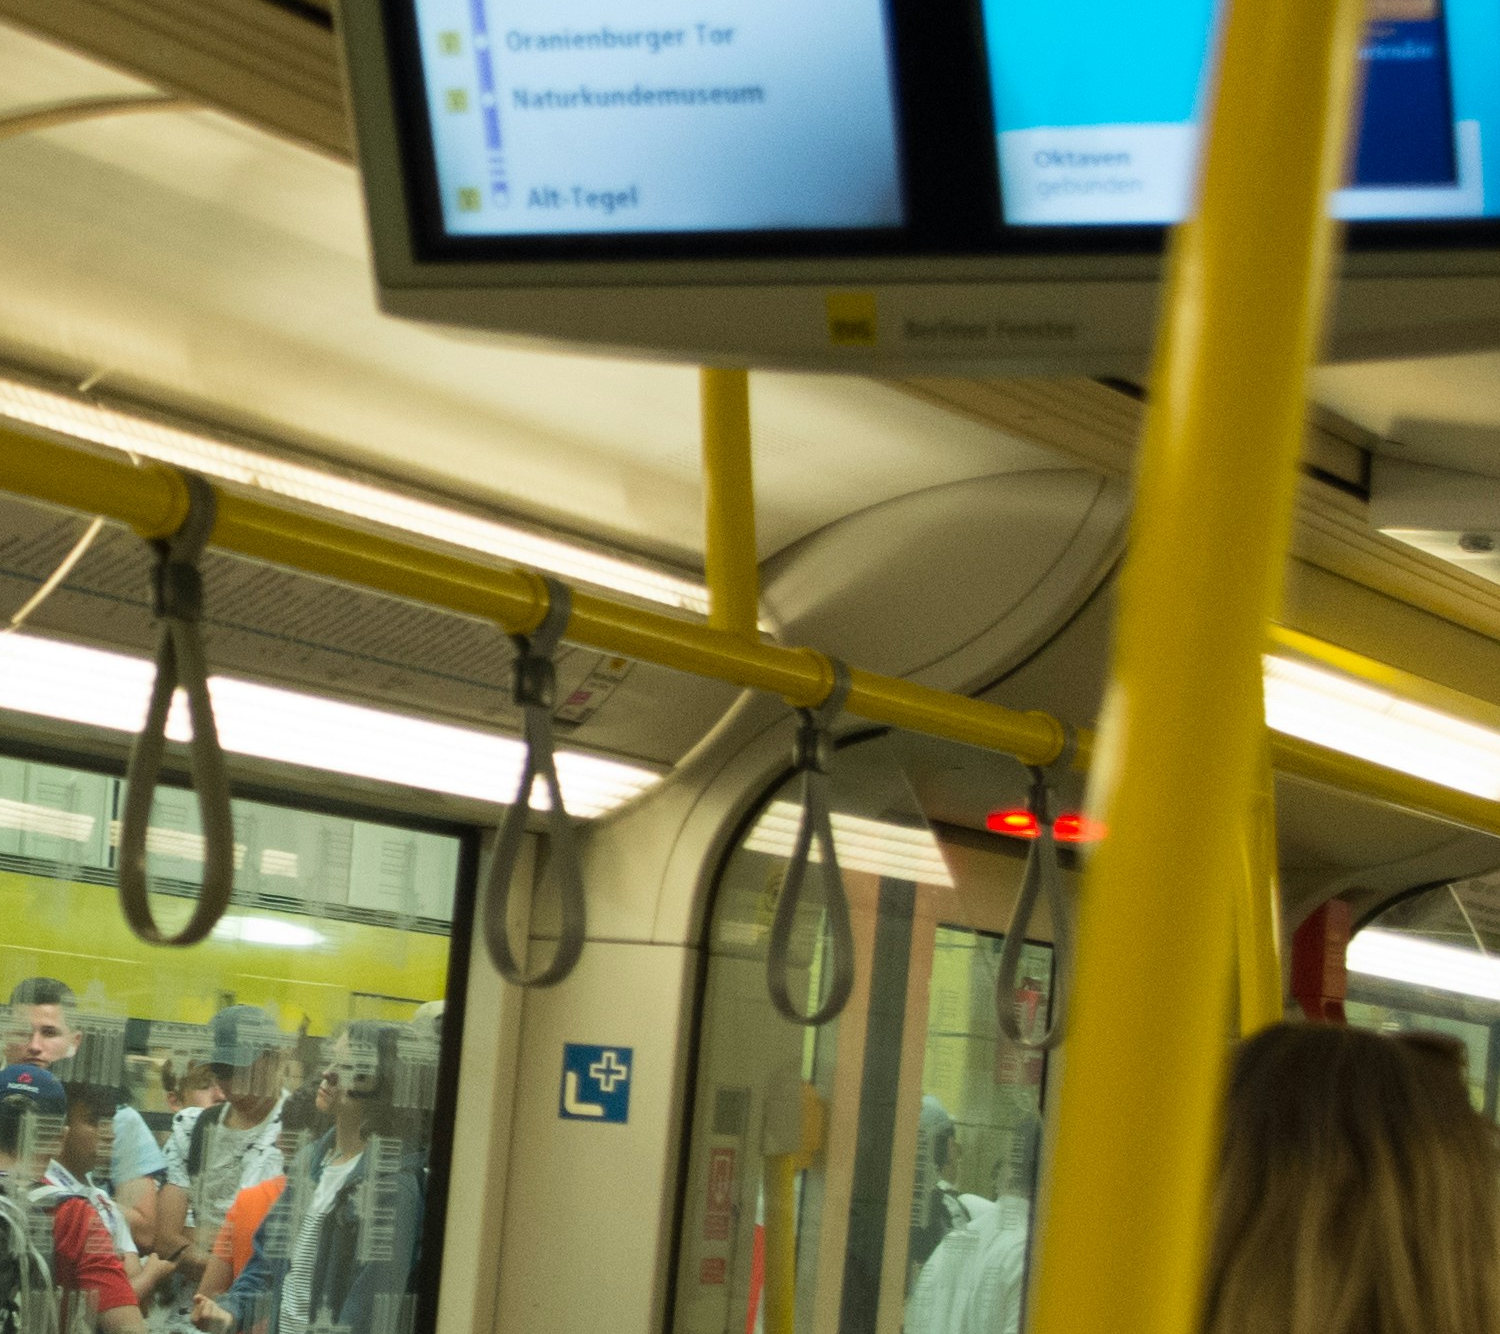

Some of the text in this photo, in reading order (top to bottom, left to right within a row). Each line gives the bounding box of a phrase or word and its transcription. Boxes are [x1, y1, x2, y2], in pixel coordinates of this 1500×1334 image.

[505, 23, 736, 54] Oranienburger Tor
[512, 82, 766, 111] Naturkundemuseum
[526, 185, 639, 215] Alt-Tegel
